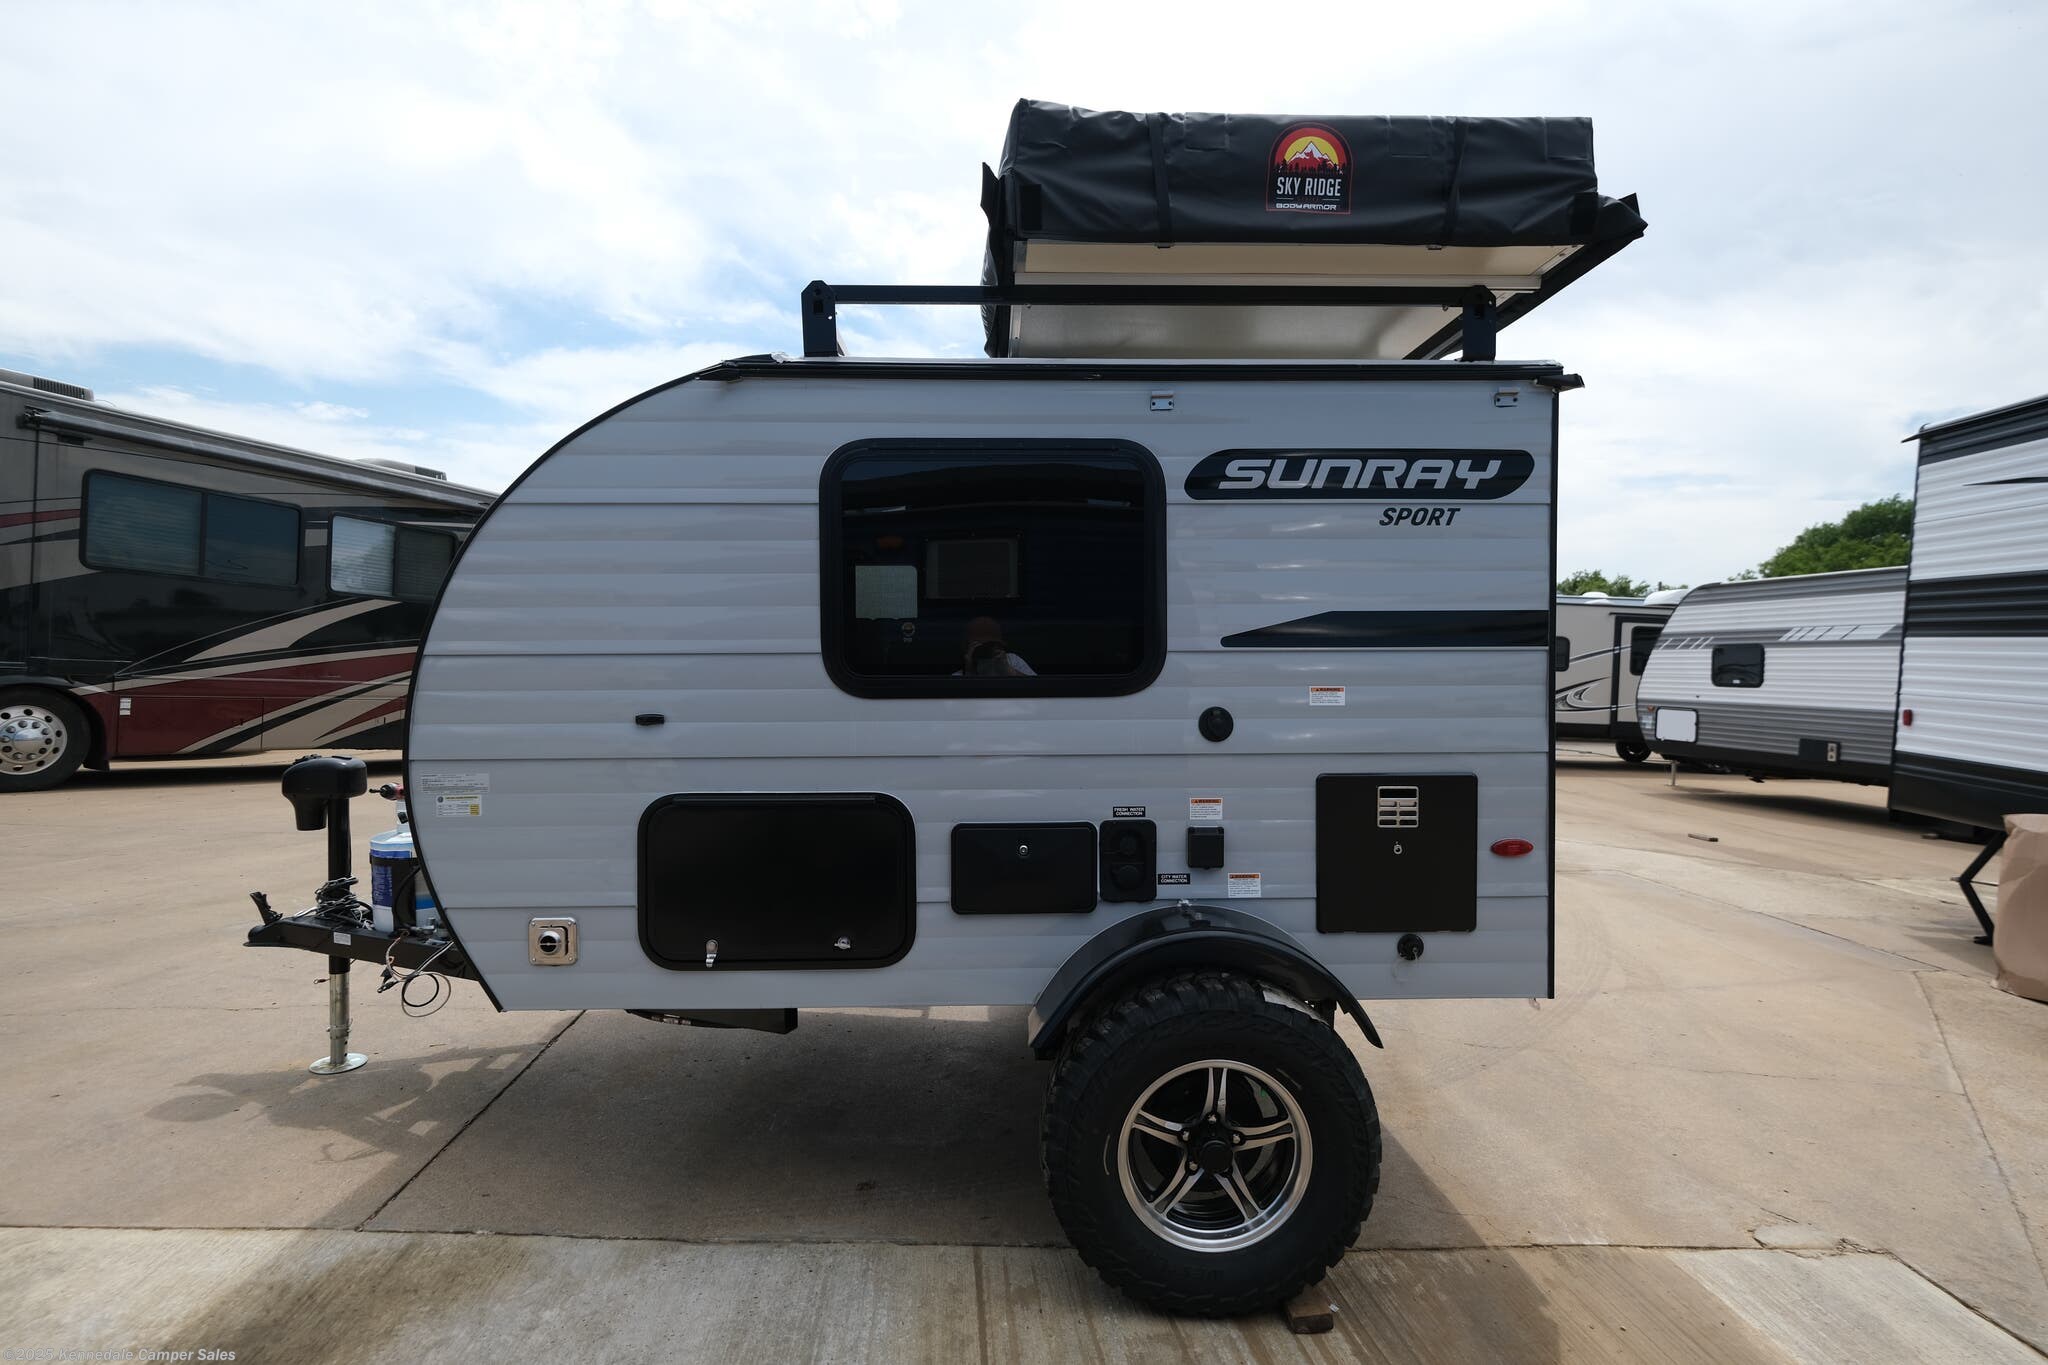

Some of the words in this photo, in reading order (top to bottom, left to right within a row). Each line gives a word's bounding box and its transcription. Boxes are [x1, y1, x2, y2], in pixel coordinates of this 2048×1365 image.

[1276, 176, 1301, 195] SKY
[1304, 177, 1342, 196] RIDGE
[1218, 459, 1502, 489] SUNRAY
[1378, 507, 1461, 526] SPORT
